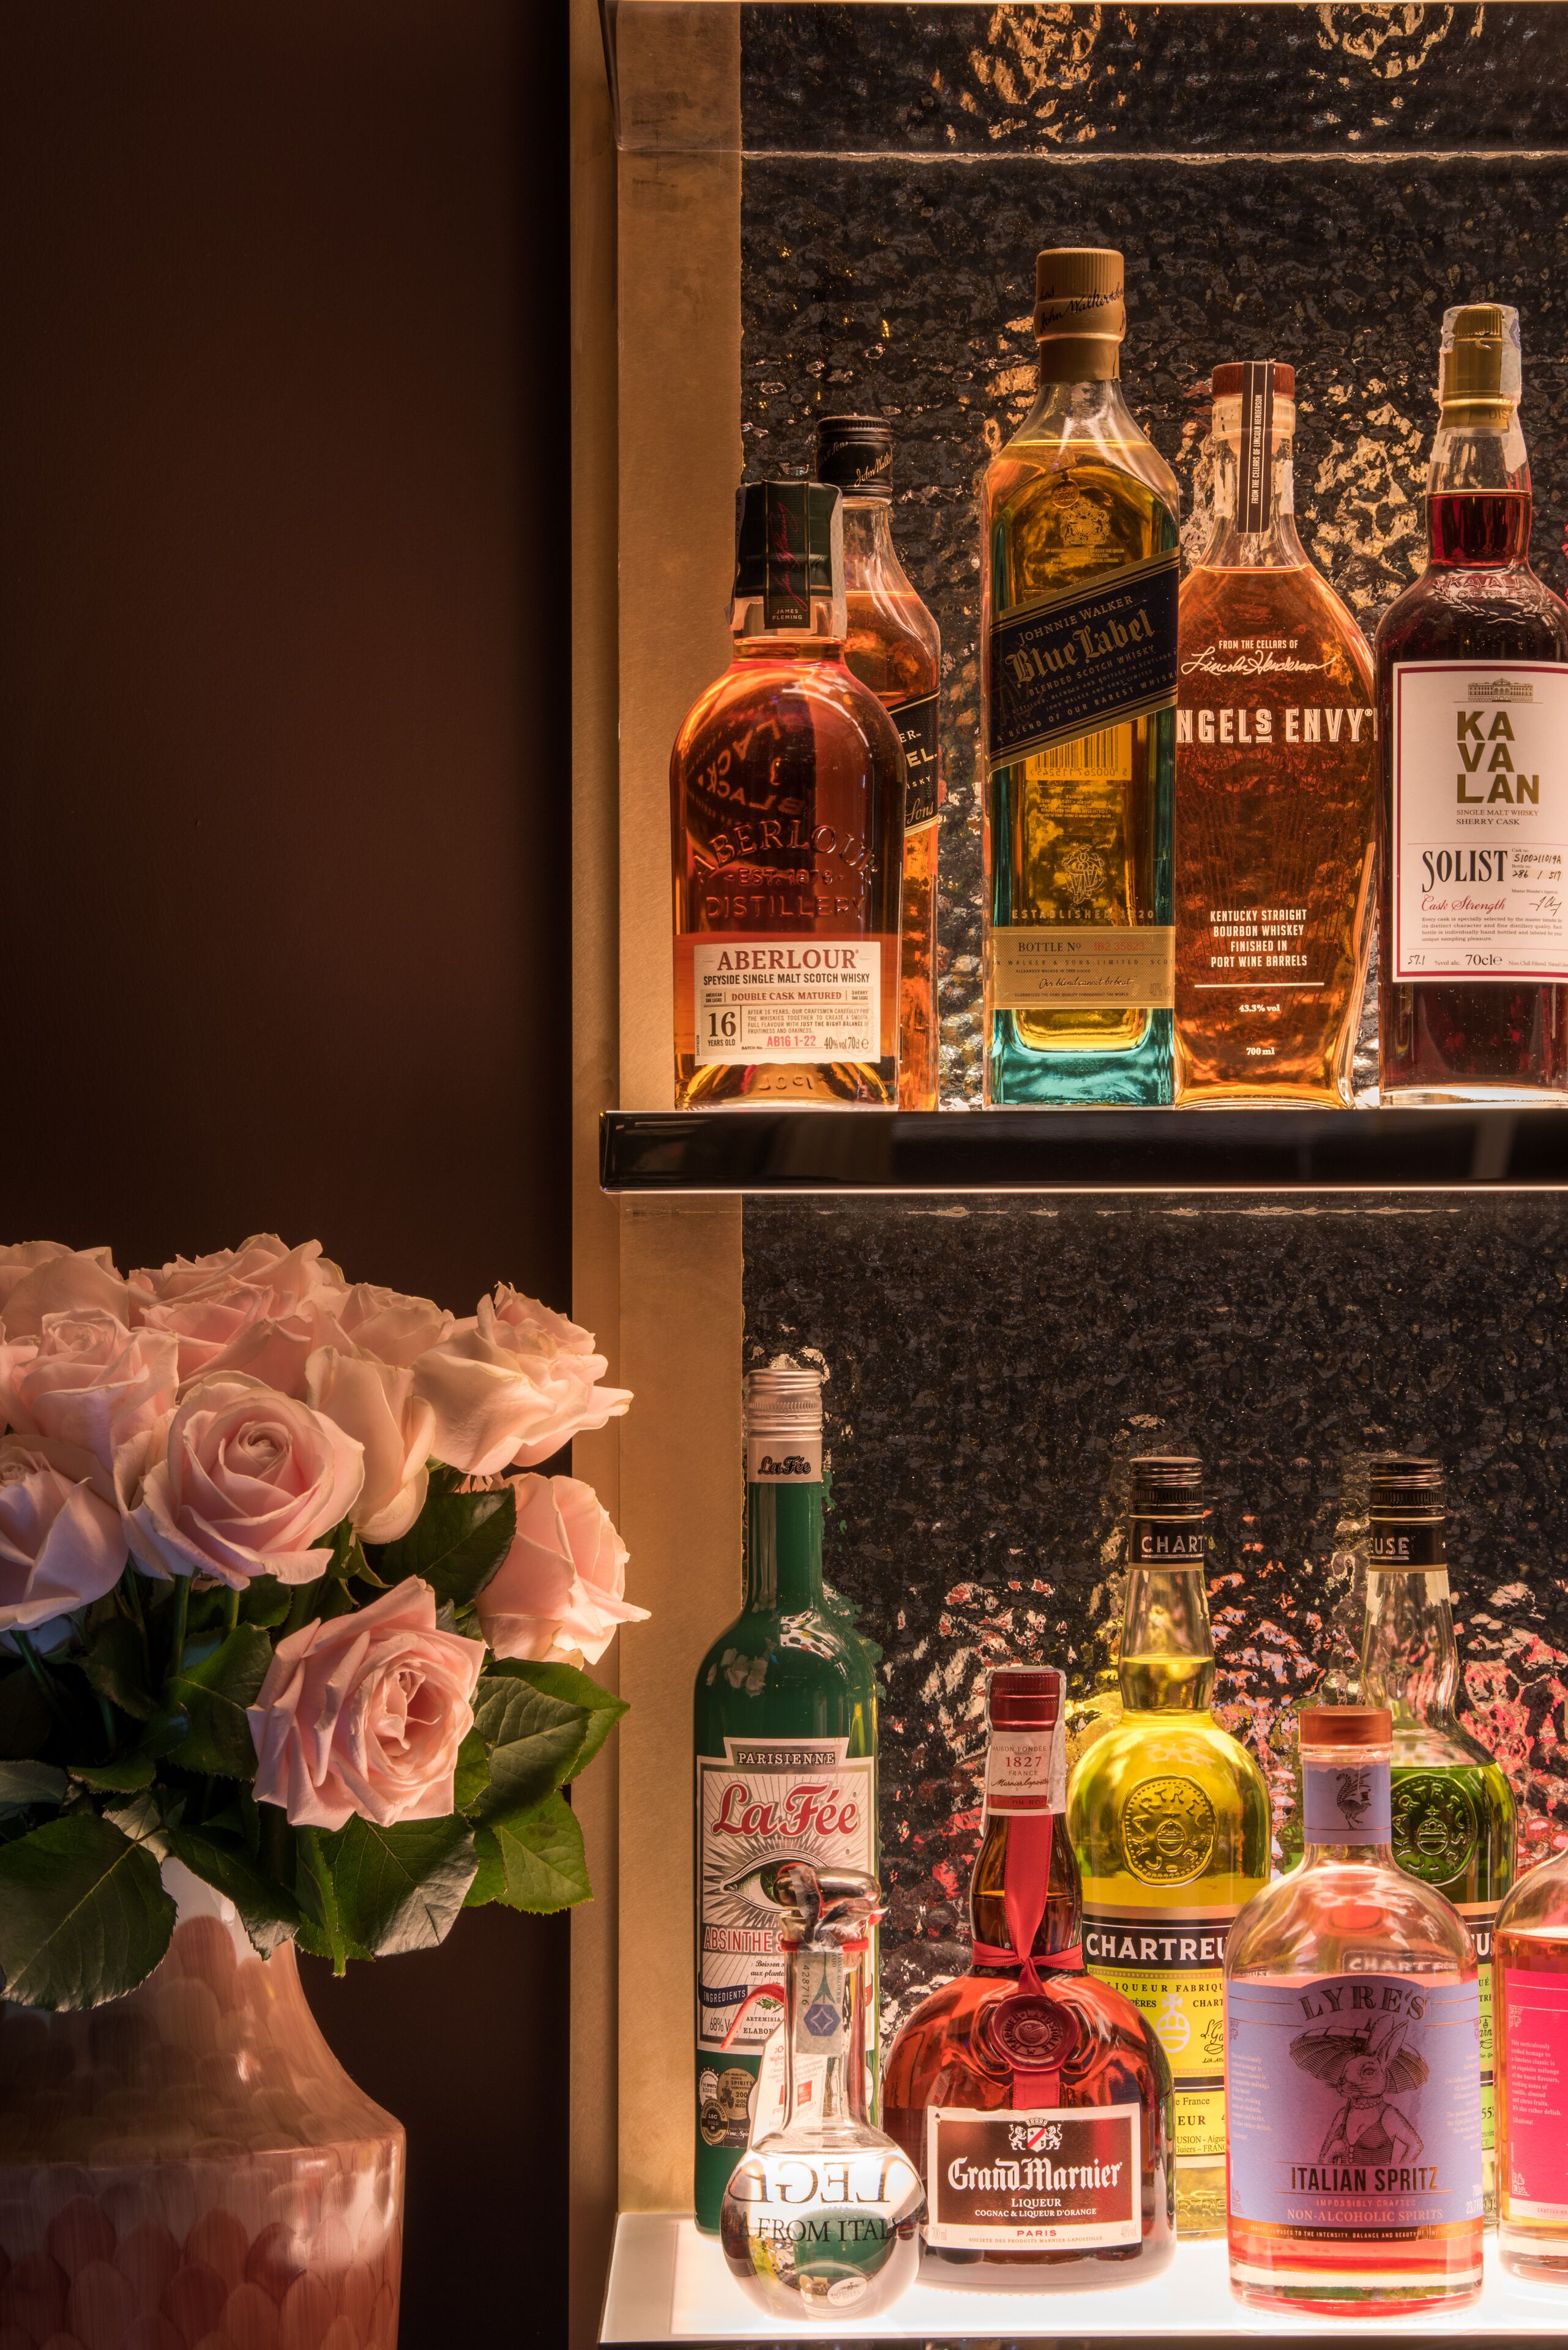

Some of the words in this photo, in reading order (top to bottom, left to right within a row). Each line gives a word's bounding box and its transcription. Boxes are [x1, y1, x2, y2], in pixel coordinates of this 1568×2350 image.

[1253, 447, 1260, 455] OF
[1018, 616, 1078, 646] JOHNNIE
[1078, 595, 1133, 621] WALKER
[1004, 642, 1078, 689] Blue
[1072, 608, 1155, 665] Label
[1219, 640, 1238, 649] FROM
[1256, 640, 1286, 649] CELLARS
[1029, 676, 1072, 696] BLENDED
[1077, 660, 1113, 679] SCOTCH
[1116, 645, 1154, 665] WHISKY
[1009, 720, 1042, 737] BLEND
[1048, 713, 1060, 723] OF
[1067, 703, 1088, 715] OUR
[1094, 687, 1134, 706] RAREST
[1285, 708, 1364, 742] ENVY
[1422, 850, 1507, 893] SOLIST
[706, 896, 866, 918] DISTILLERY
[1421, 894, 1447, 911] Cask
[1452, 895, 1507, 914] Strength
[1012, 909, 1111, 919] ESTABLISHED
[1210, 911, 1257, 922] KENTUCKY
[1261, 909, 1307, 920] STRAIGHT
[1214, 926, 1258, 937] BOURBON
[1262, 925, 1304, 936] WHISKEY
[1018, 942, 1063, 952] BOTTLE
[1231, 941, 1274, 952] FINISHED
[1278, 941, 1287, 951] IN
[717, 949, 856, 971] ABERLOUR
[1211, 957, 1234, 967] PORT
[1239, 957, 1262, 967] WINE
[1266, 955, 1307, 966] BARRELS
[1465, 954, 1493, 965] 70cl
[704, 974, 740, 985] SPEYSIDE
[743, 974, 774, 984] SINGLE
[778, 974, 801, 983] MALT
[804, 973, 838, 983] SCOTCH
[840, 973, 870, 983] WHISKY
[708, 1011, 736, 1037] 16
[767, 1035, 791, 1047] AB16
[794, 1035, 816, 1046] 1-22
[824, 1039, 838, 1050] 40%
[737, 1751, 835, 1764] PARISIENNE
[1006, 1756, 1042, 1767] 1827
[704, 1926, 772, 1953] ABSINTHE
[703, 1989, 745, 2003] INGRÉDIENTS
[1298, 1986, 1428, 2021] LYRE'S
[709, 2017, 723, 2032] 68%
[948, 2157, 1020, 2190] Grand
[1018, 2158, 1120, 2191] Marnier
[1291, 2168, 1366, 2191] ITALIAN
[1375, 2166, 1438, 2191] SPRITZ
[1011, 2198, 1061, 2209] LIQUEUR
[1018, 2209, 1055, 2218] LIQUEUR
[1287, 2210, 1394, 2222] NON-ALCOHOLIC
[1398, 2209, 1444, 2221] SPIRITS
[758, 2218, 830, 2242] FROM
